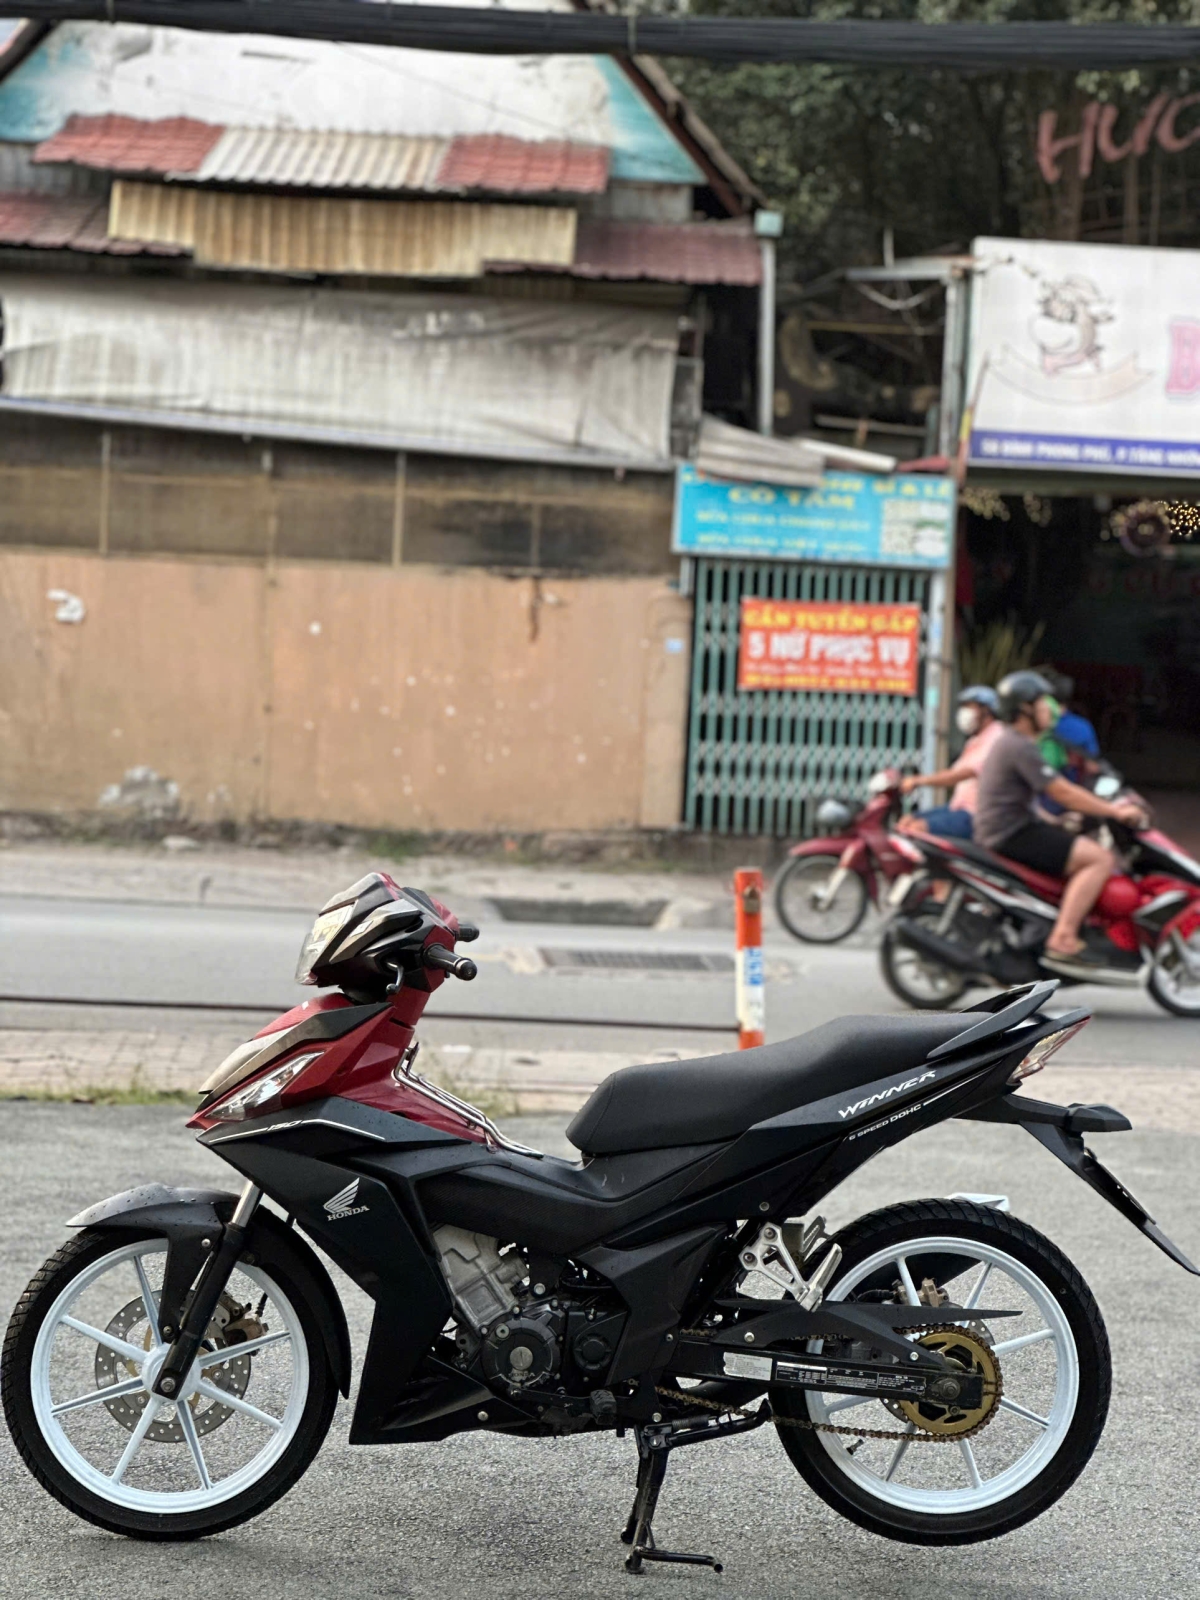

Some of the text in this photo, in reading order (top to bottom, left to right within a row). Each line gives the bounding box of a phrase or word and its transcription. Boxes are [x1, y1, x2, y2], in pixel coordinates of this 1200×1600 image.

[838, 1070, 937, 1118] WINNER
[857, 1120, 889, 1137] SPEED
[890, 1104, 921, 1123] DOHC
[327, 1205, 370, 1221] HONDA
